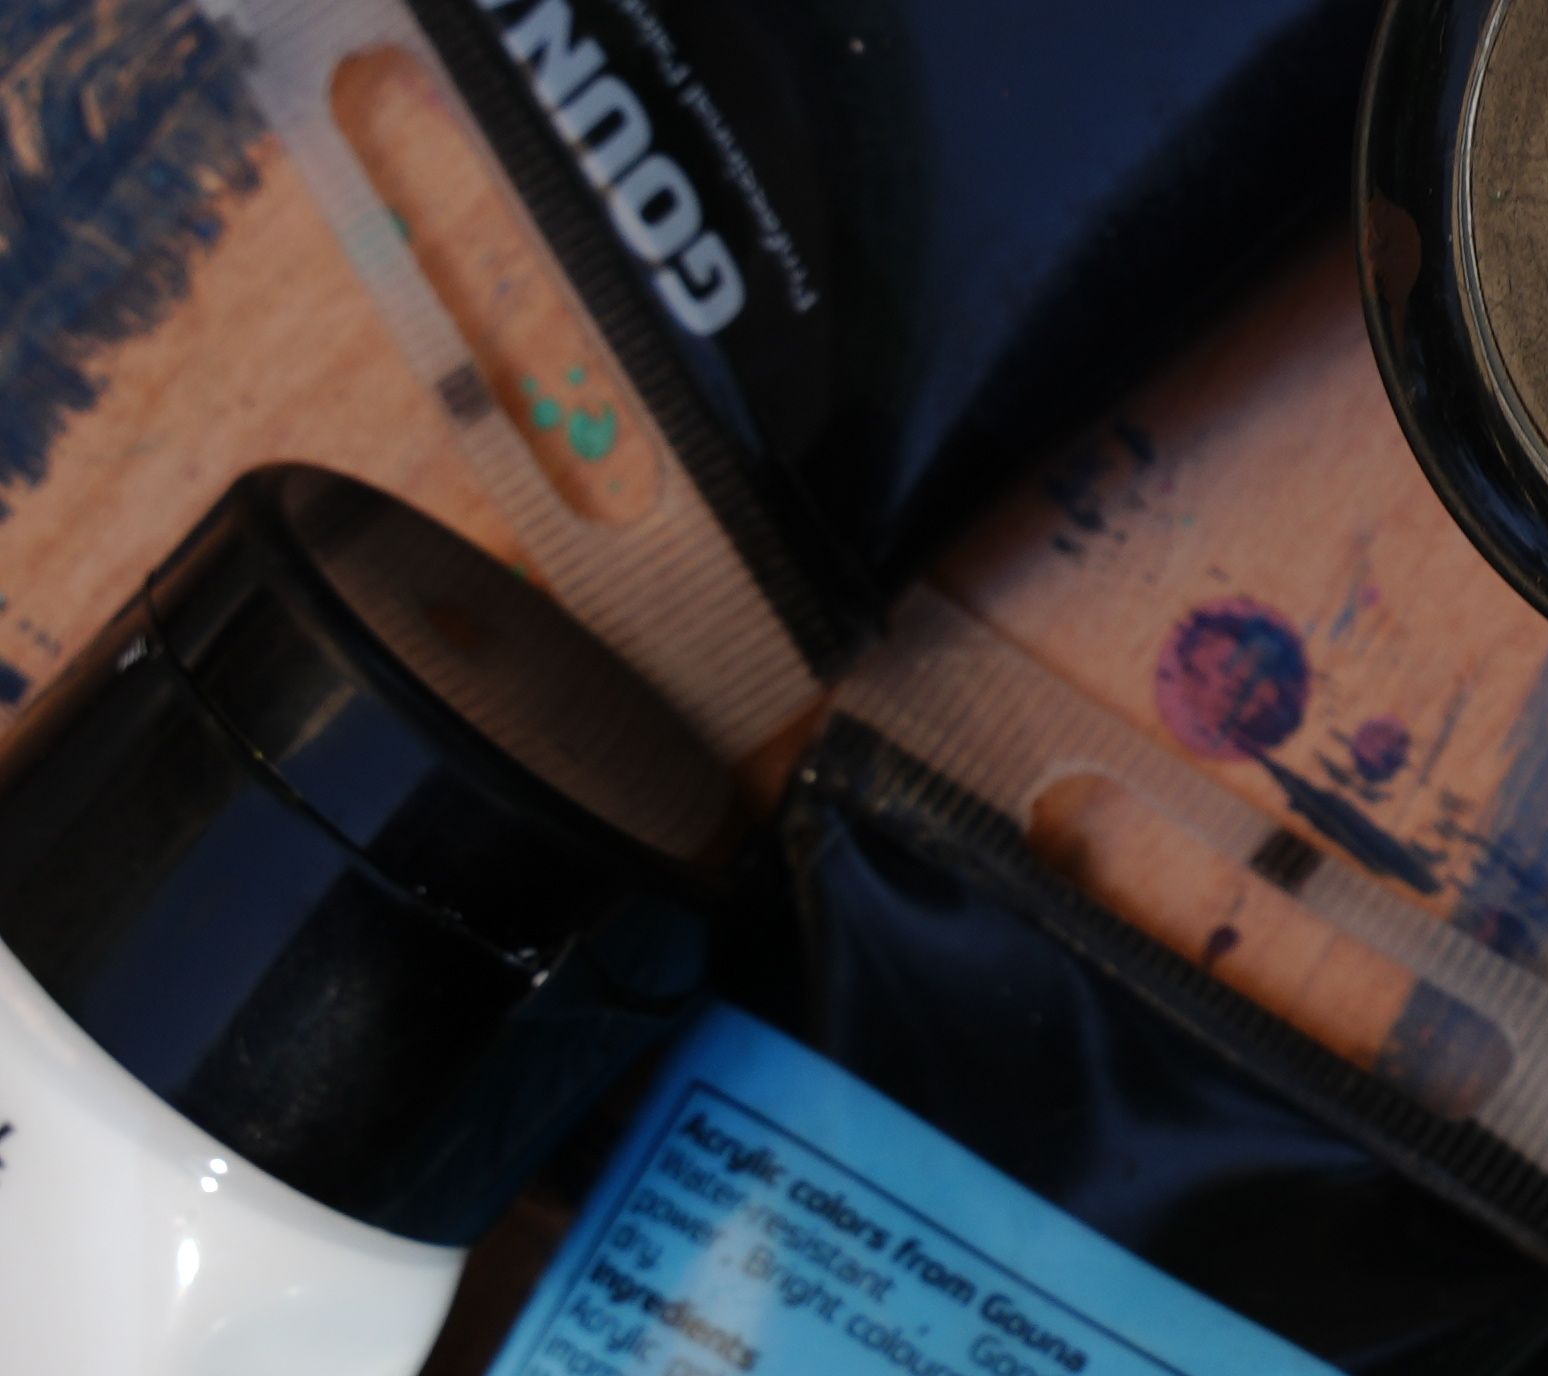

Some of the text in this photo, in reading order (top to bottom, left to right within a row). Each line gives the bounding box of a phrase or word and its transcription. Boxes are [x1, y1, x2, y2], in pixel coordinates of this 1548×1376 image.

[682, 1114, 1089, 1375] Acrylic colors from Gouna
[744, 1252, 845, 1324] Bright
[568, 1295, 655, 1363] Acrylic
[589, 1258, 761, 1373] Ingredients
